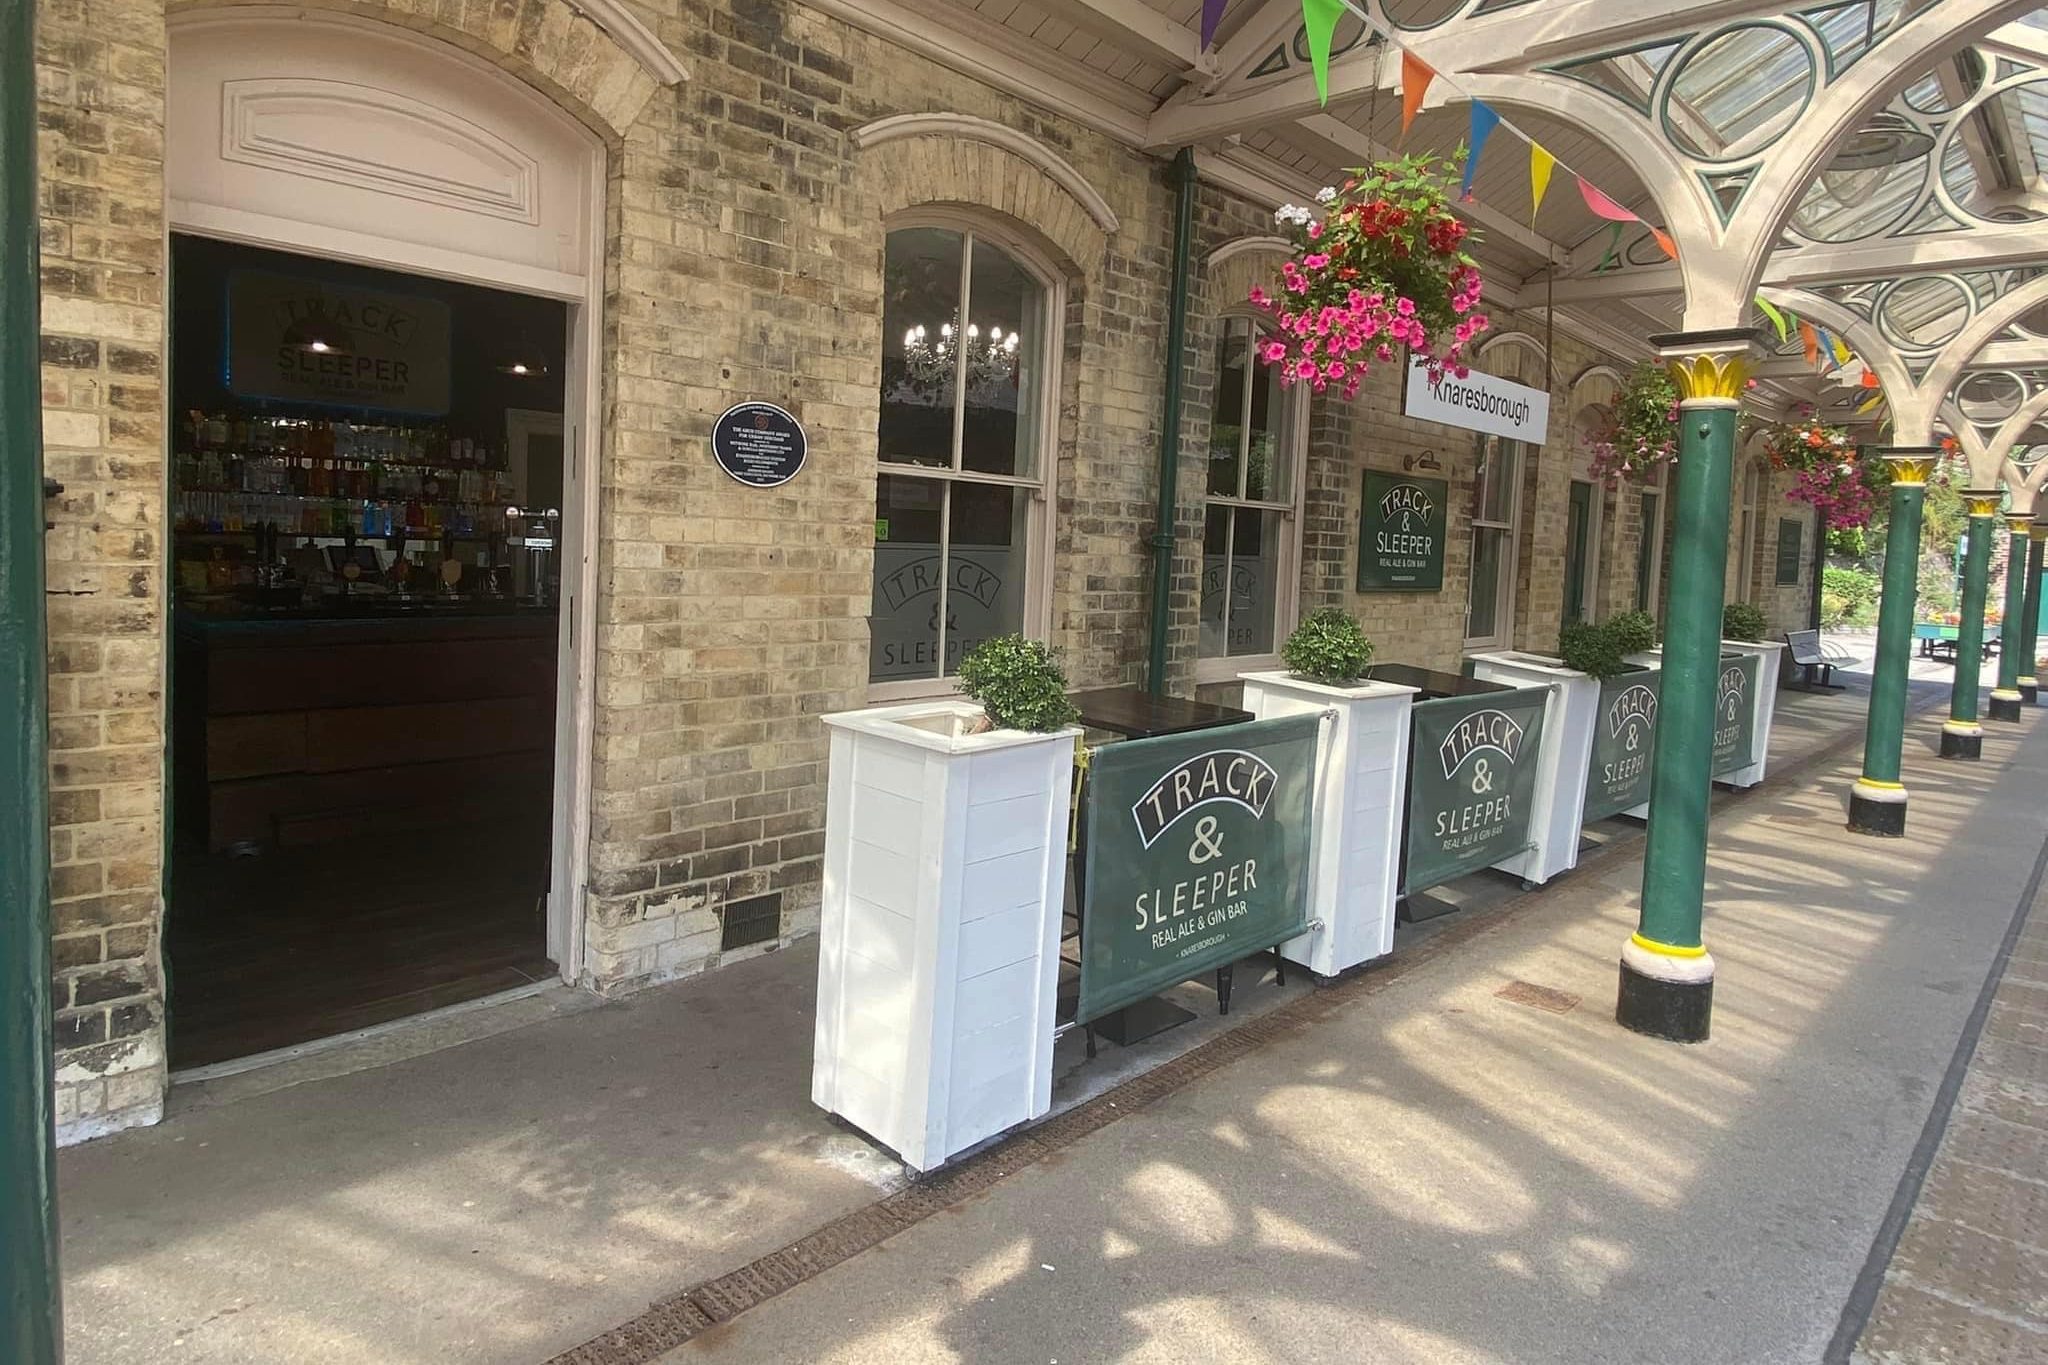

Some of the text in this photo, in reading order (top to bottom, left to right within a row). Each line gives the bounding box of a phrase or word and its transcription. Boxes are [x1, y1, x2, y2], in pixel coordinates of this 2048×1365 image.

[282, 296, 408, 338] TRACK
[277, 347, 409, 383] SLEEPER
[1434, 379, 1530, 426] Knaresborough
[1382, 488, 1432, 519] TRACK
[1402, 511, 1410, 532] &
[1376, 531, 1432, 555] SLEEPER
[928, 601, 958, 630] &
[883, 638, 986, 666] SLEEPE
[1614, 689, 1653, 726] TRACK
[1727, 698, 1736, 720] &
[1447, 715, 1516, 764] TRACK
[1625, 723, 1639, 751] &
[1471, 758, 1493, 794] &
[1603, 752, 1646, 783] SLEEPER
[1146, 757, 1268, 827] TRACK
[1434, 794, 1511, 837] SLEEPER
[1188, 815, 1224, 864] &
[1135, 858, 1257, 931] SLEEPER
[1152, 900, 1248, 950] REAL ALE & GIN BAR
